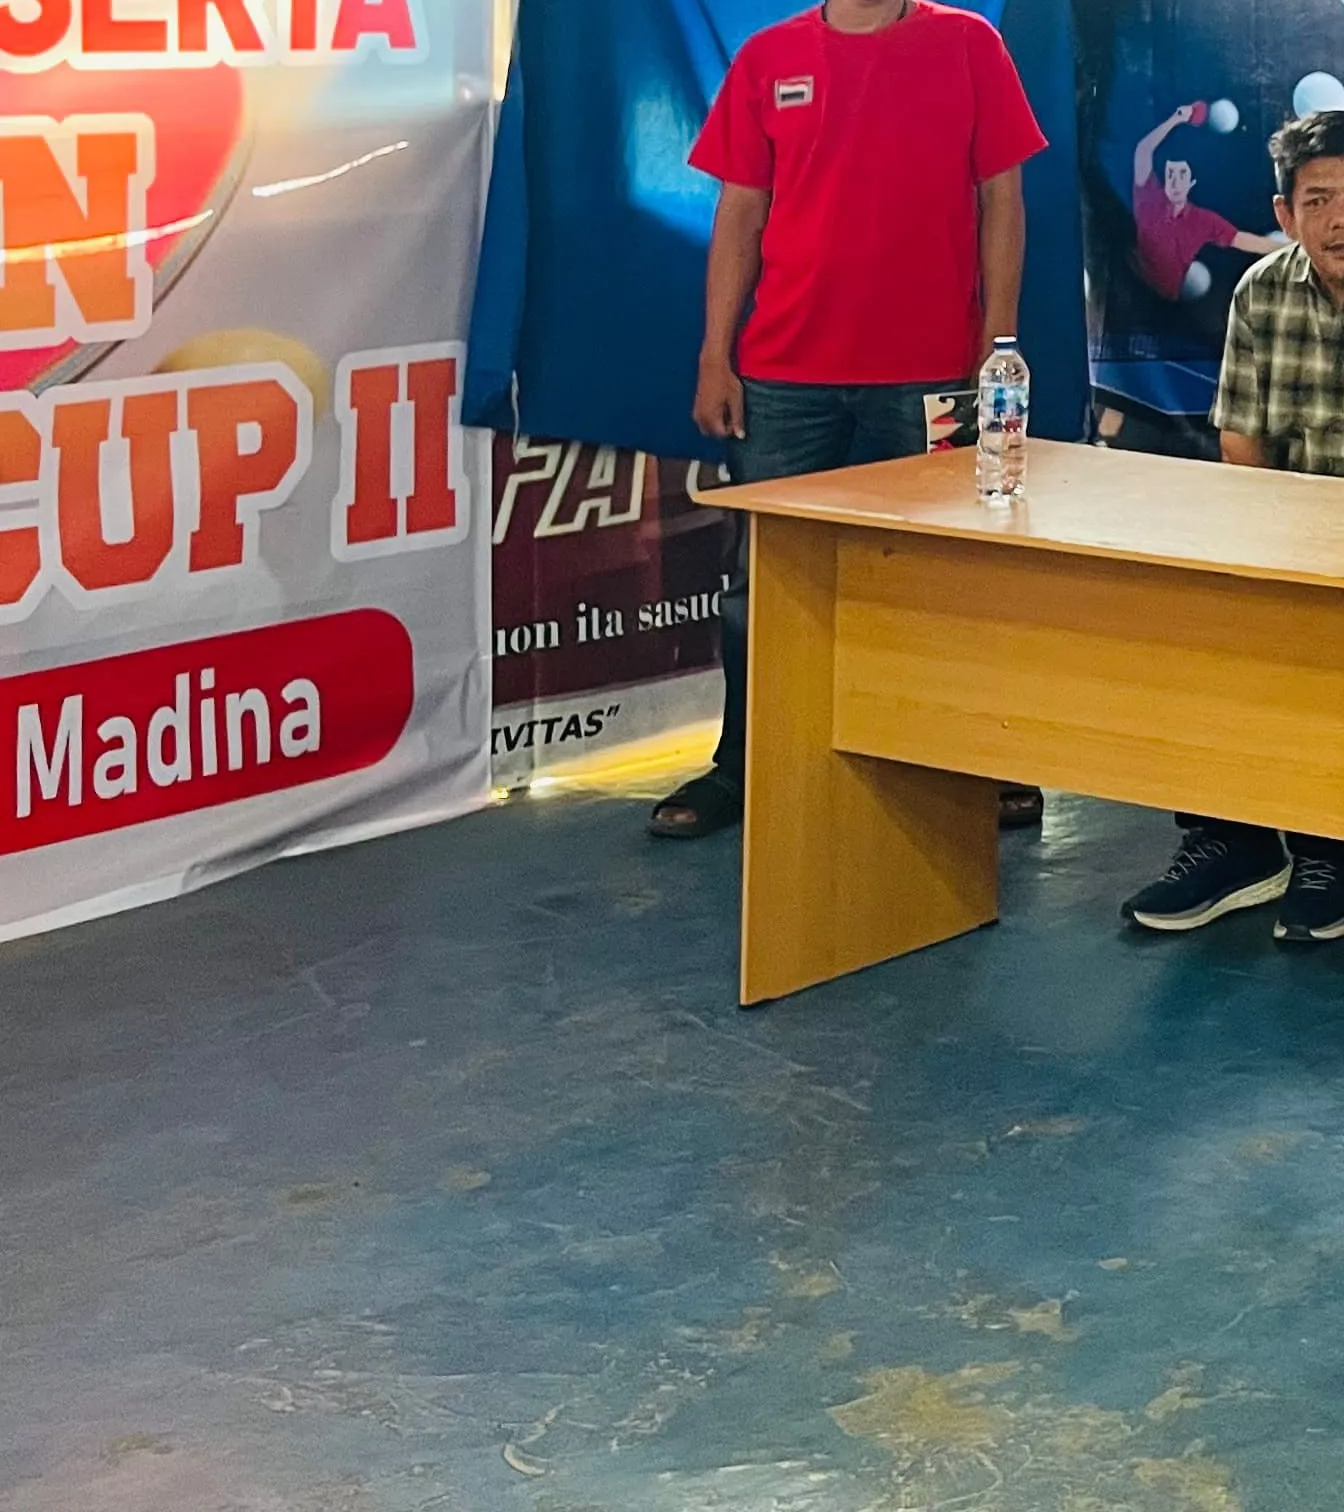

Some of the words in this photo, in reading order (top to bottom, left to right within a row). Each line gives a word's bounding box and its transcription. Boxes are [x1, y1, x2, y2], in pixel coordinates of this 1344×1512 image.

[347, 356, 458, 545] II
[576, 601, 625, 643] ita
[15, 664, 323, 819] Madina
